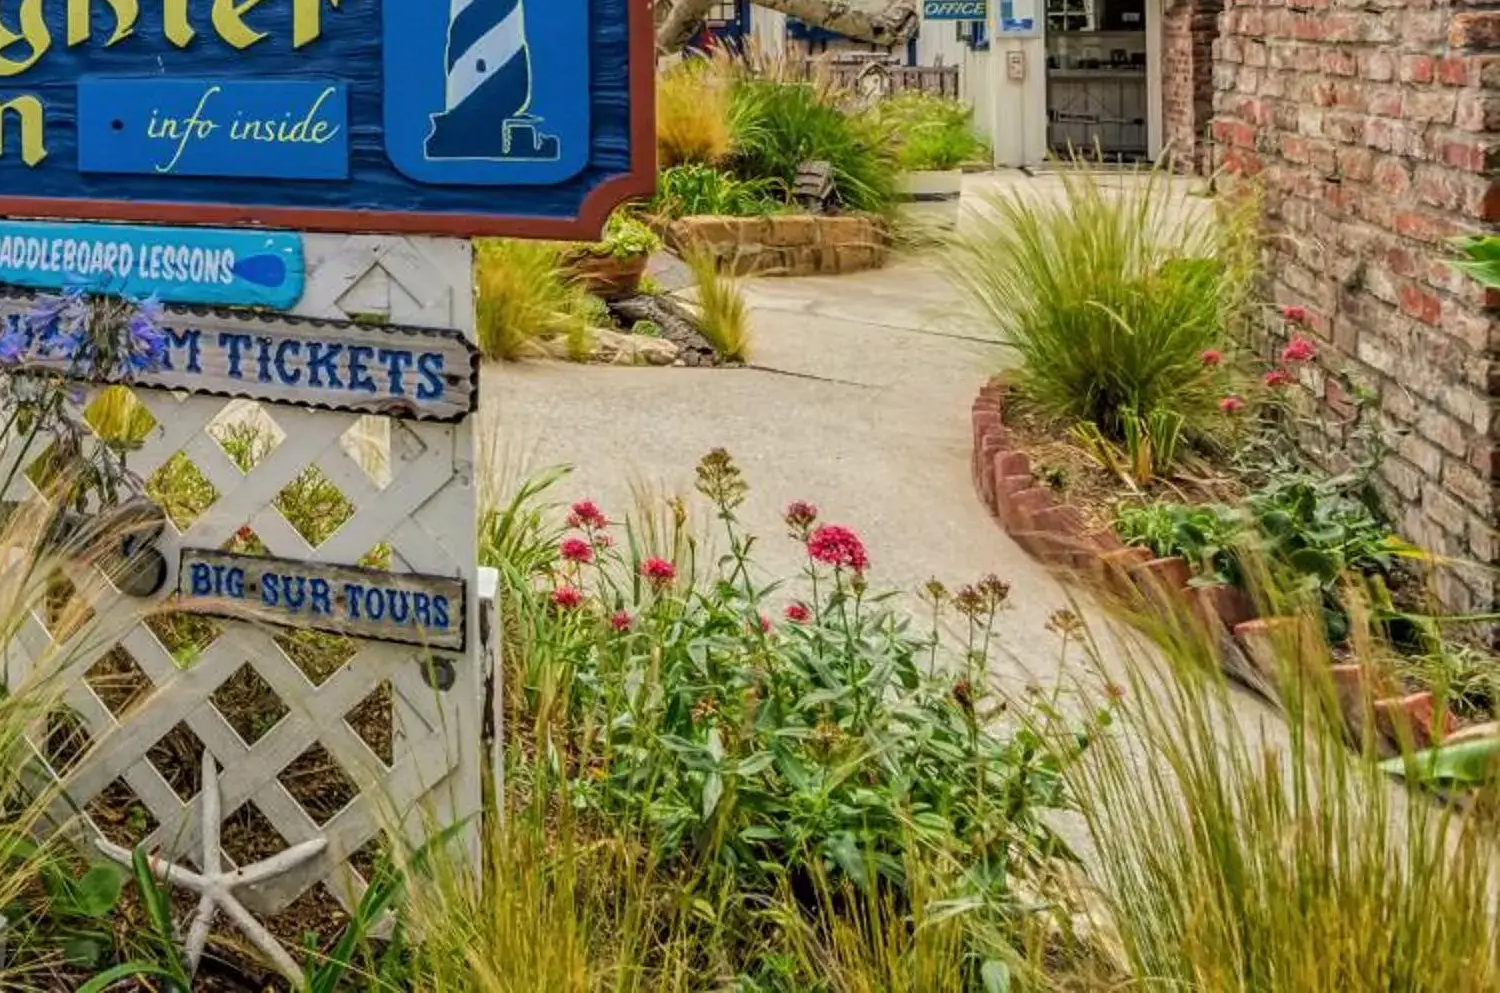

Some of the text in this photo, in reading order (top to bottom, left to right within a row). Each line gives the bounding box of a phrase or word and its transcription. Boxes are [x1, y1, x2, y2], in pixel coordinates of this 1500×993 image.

[925, 1, 986, 16] OFFICE
[146, 86, 341, 172] info inside
[138, 246, 236, 286] LESSONS
[217, 332, 446, 401] TICKETS
[189, 562, 450, 628] BIG SUR TOURS
